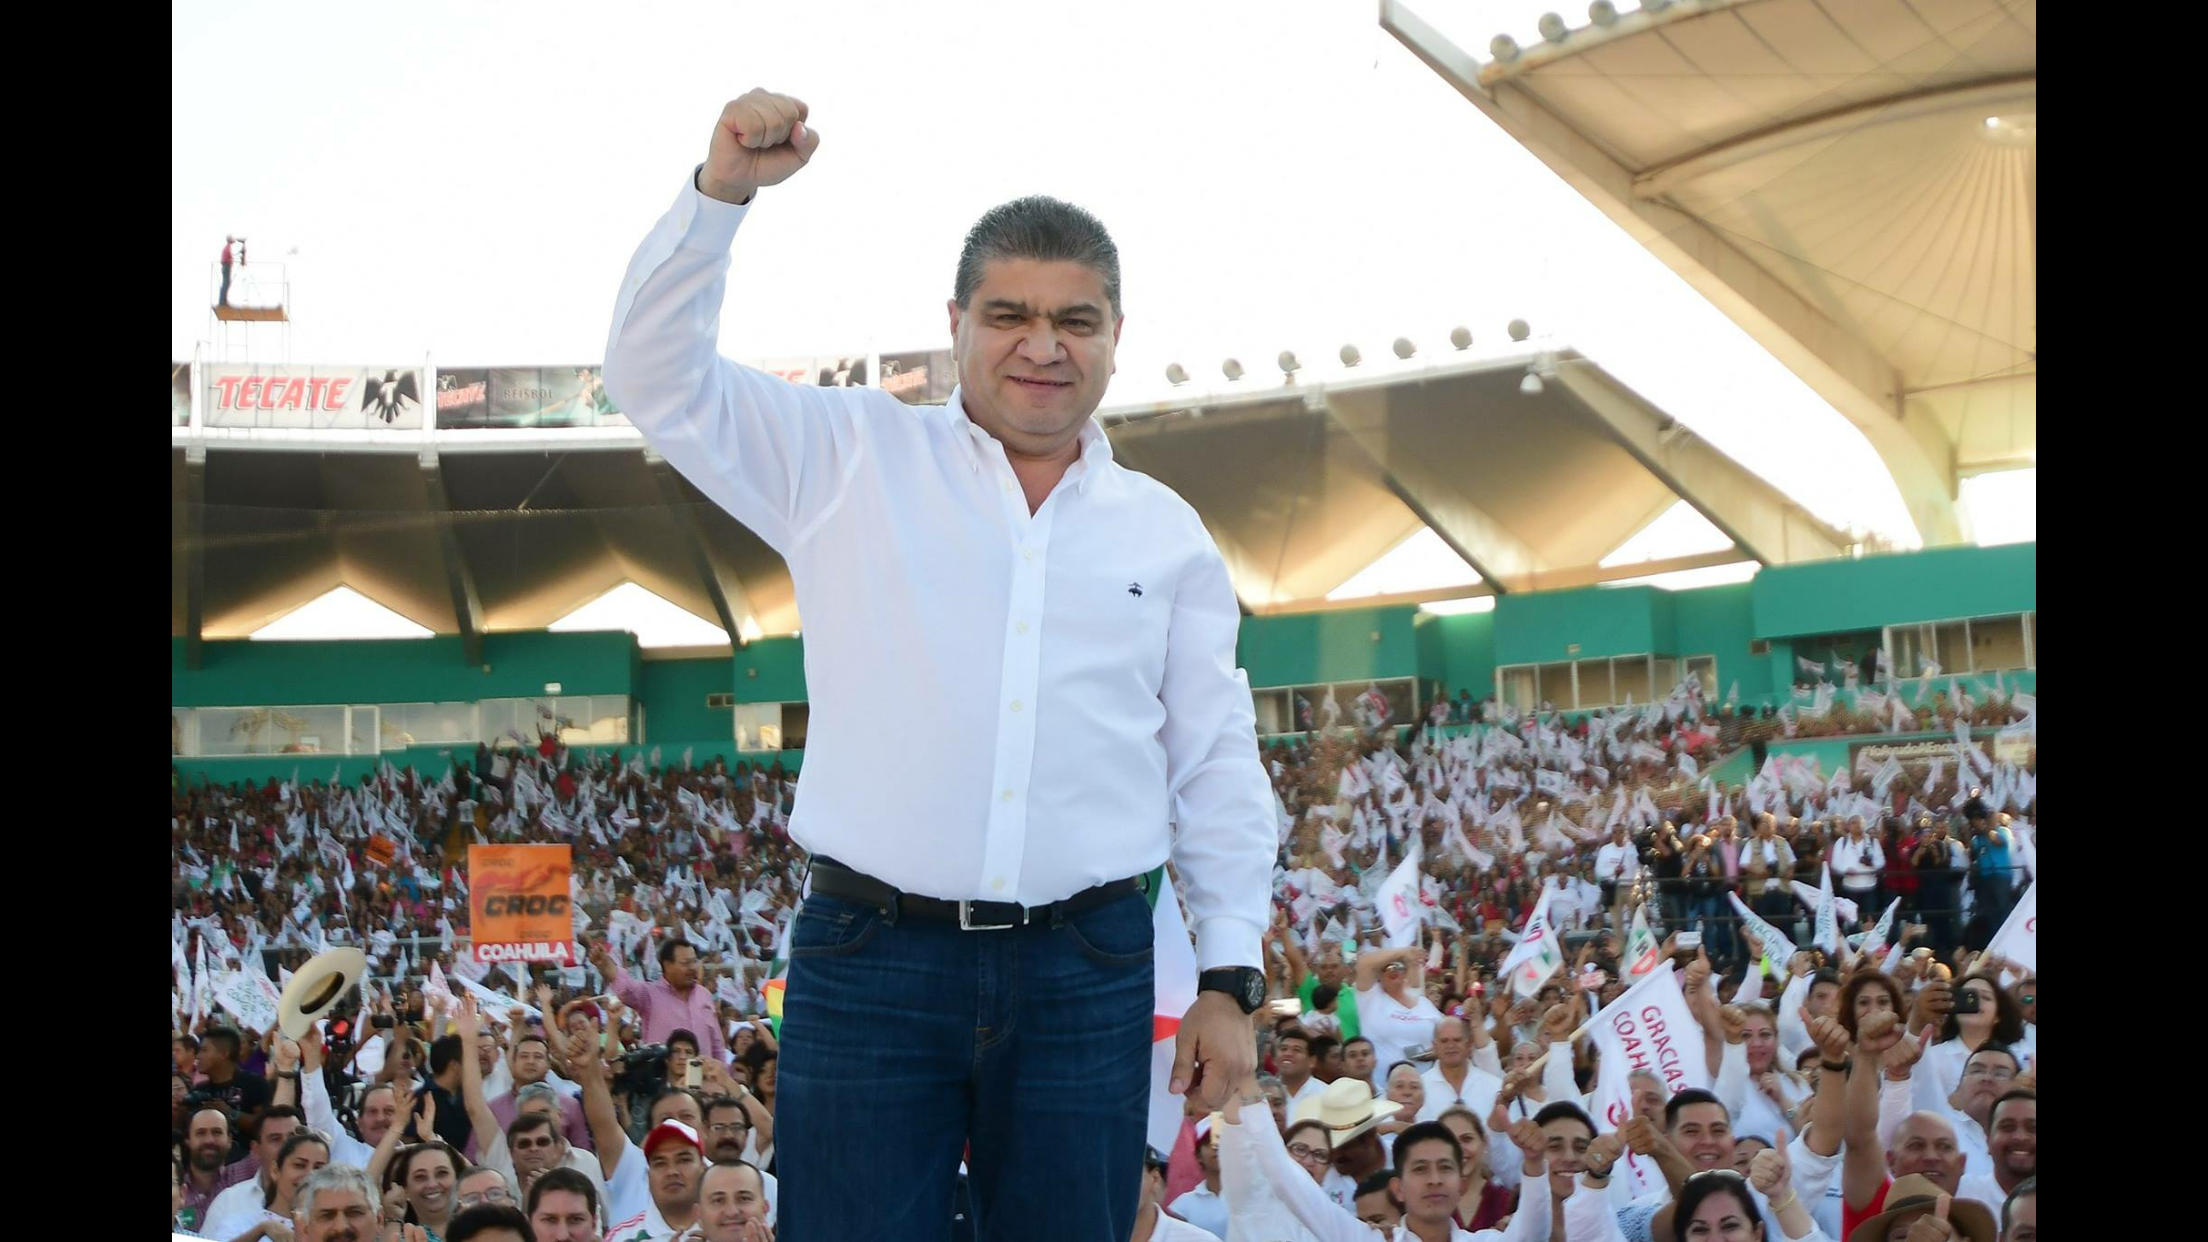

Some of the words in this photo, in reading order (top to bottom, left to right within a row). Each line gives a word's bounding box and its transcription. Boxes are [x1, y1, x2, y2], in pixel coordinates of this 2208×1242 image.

[214, 377, 352, 411] TECATE
[485, 894, 569, 917] CROC
[478, 941, 569, 961] COAHUILA
[1612, 1010, 1653, 1072] COAH
[1641, 1004, 1690, 1097] GRACIAS
